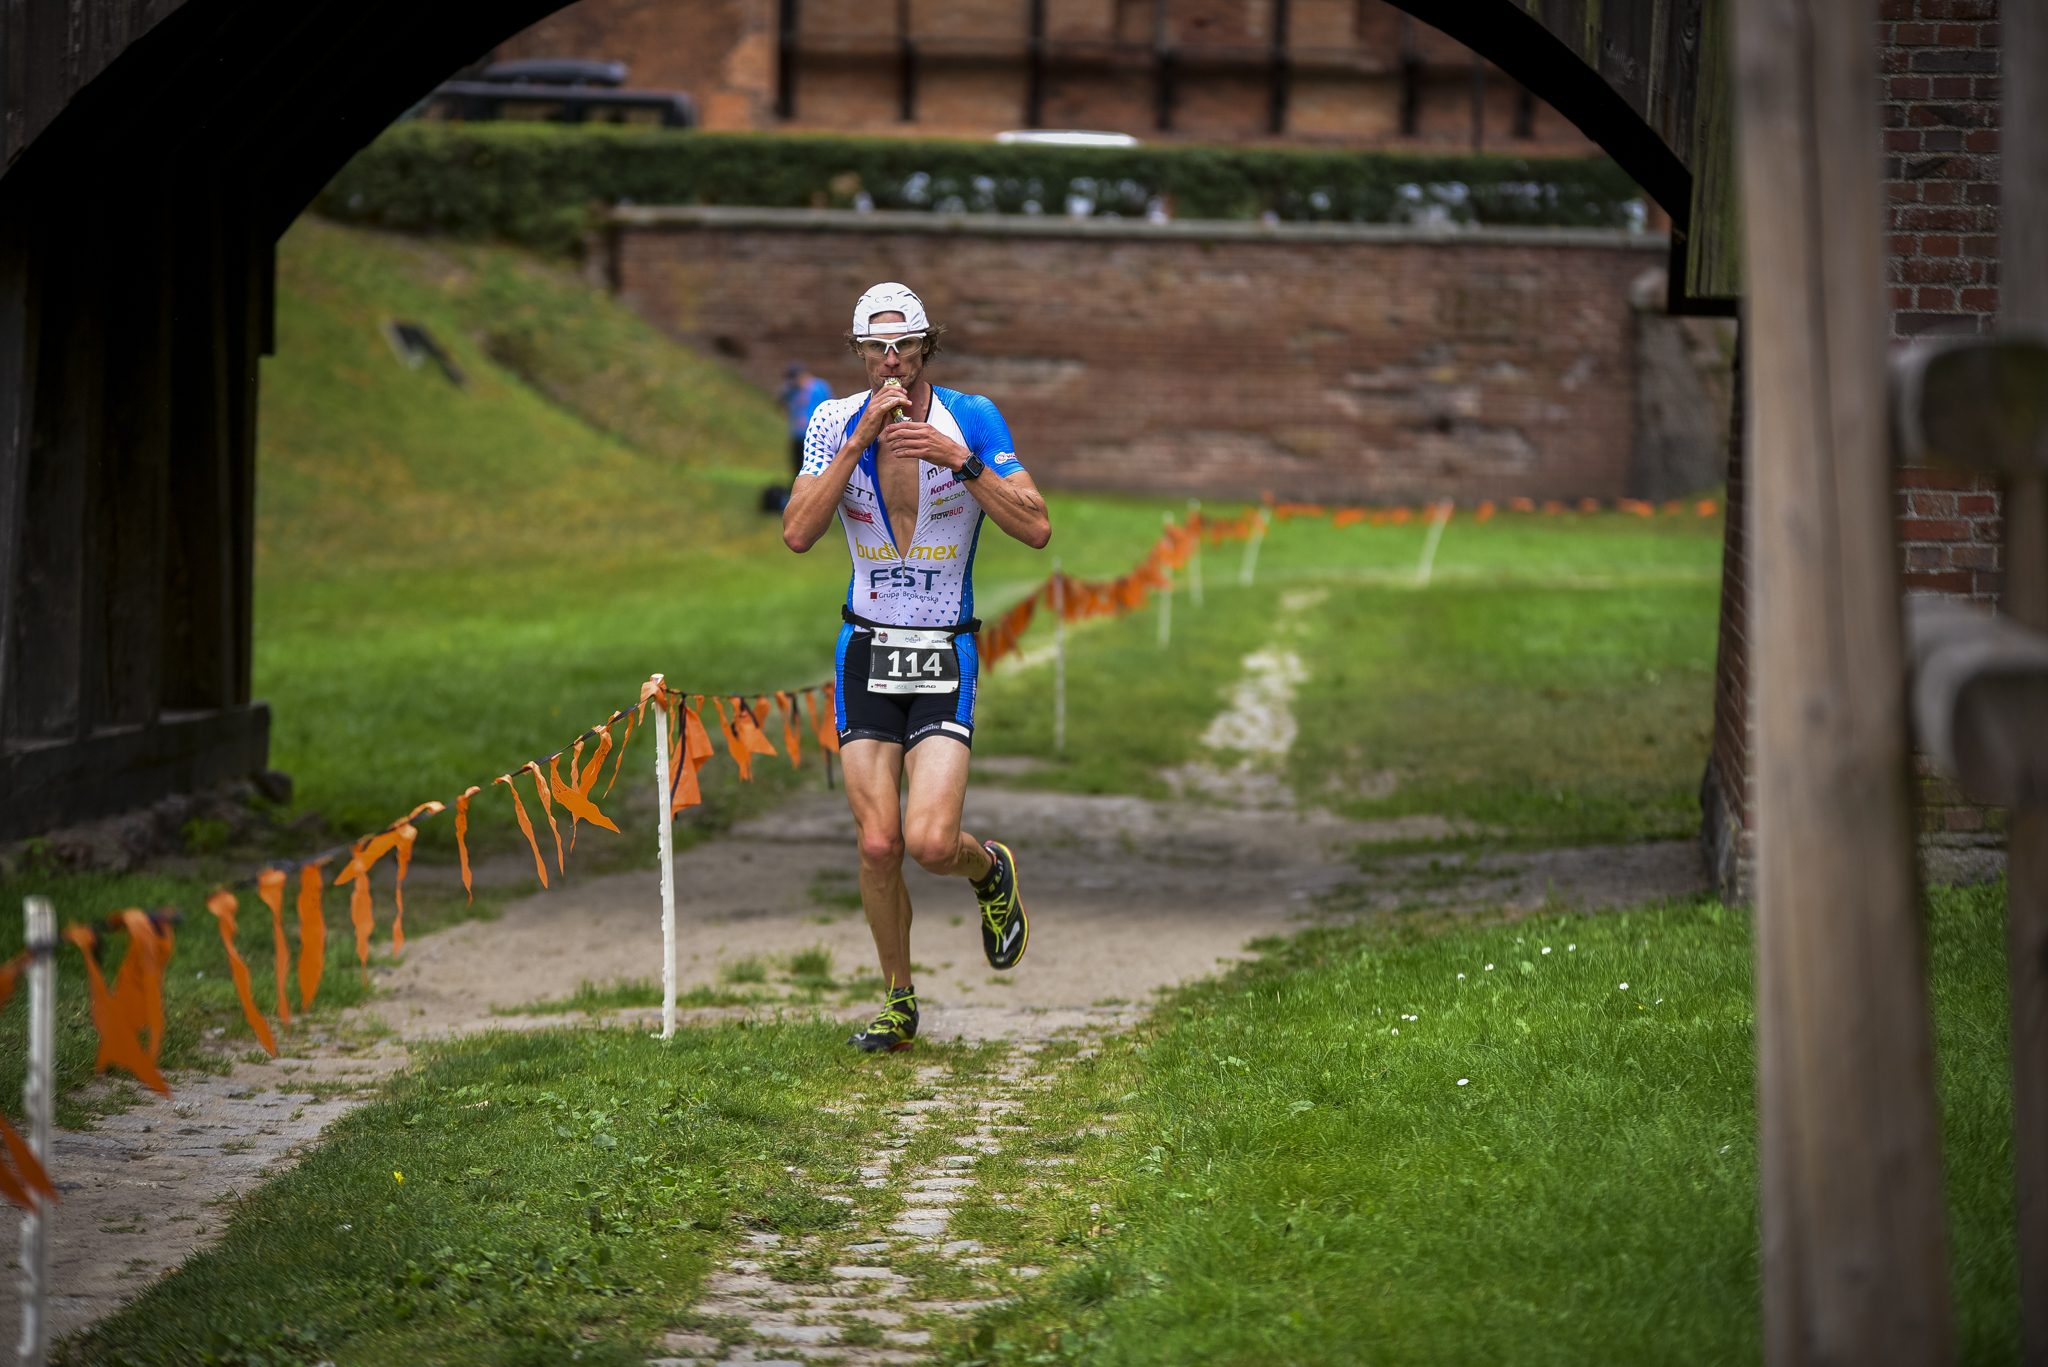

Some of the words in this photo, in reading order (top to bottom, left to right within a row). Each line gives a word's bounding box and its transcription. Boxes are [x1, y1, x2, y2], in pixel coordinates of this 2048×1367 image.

[930, 479, 961, 495] Koron
[870, 566, 941, 591] FST
[878, 591, 900, 601] Grupa
[902, 590, 939, 603] Brokerska
[887, 650, 943, 678] 114
